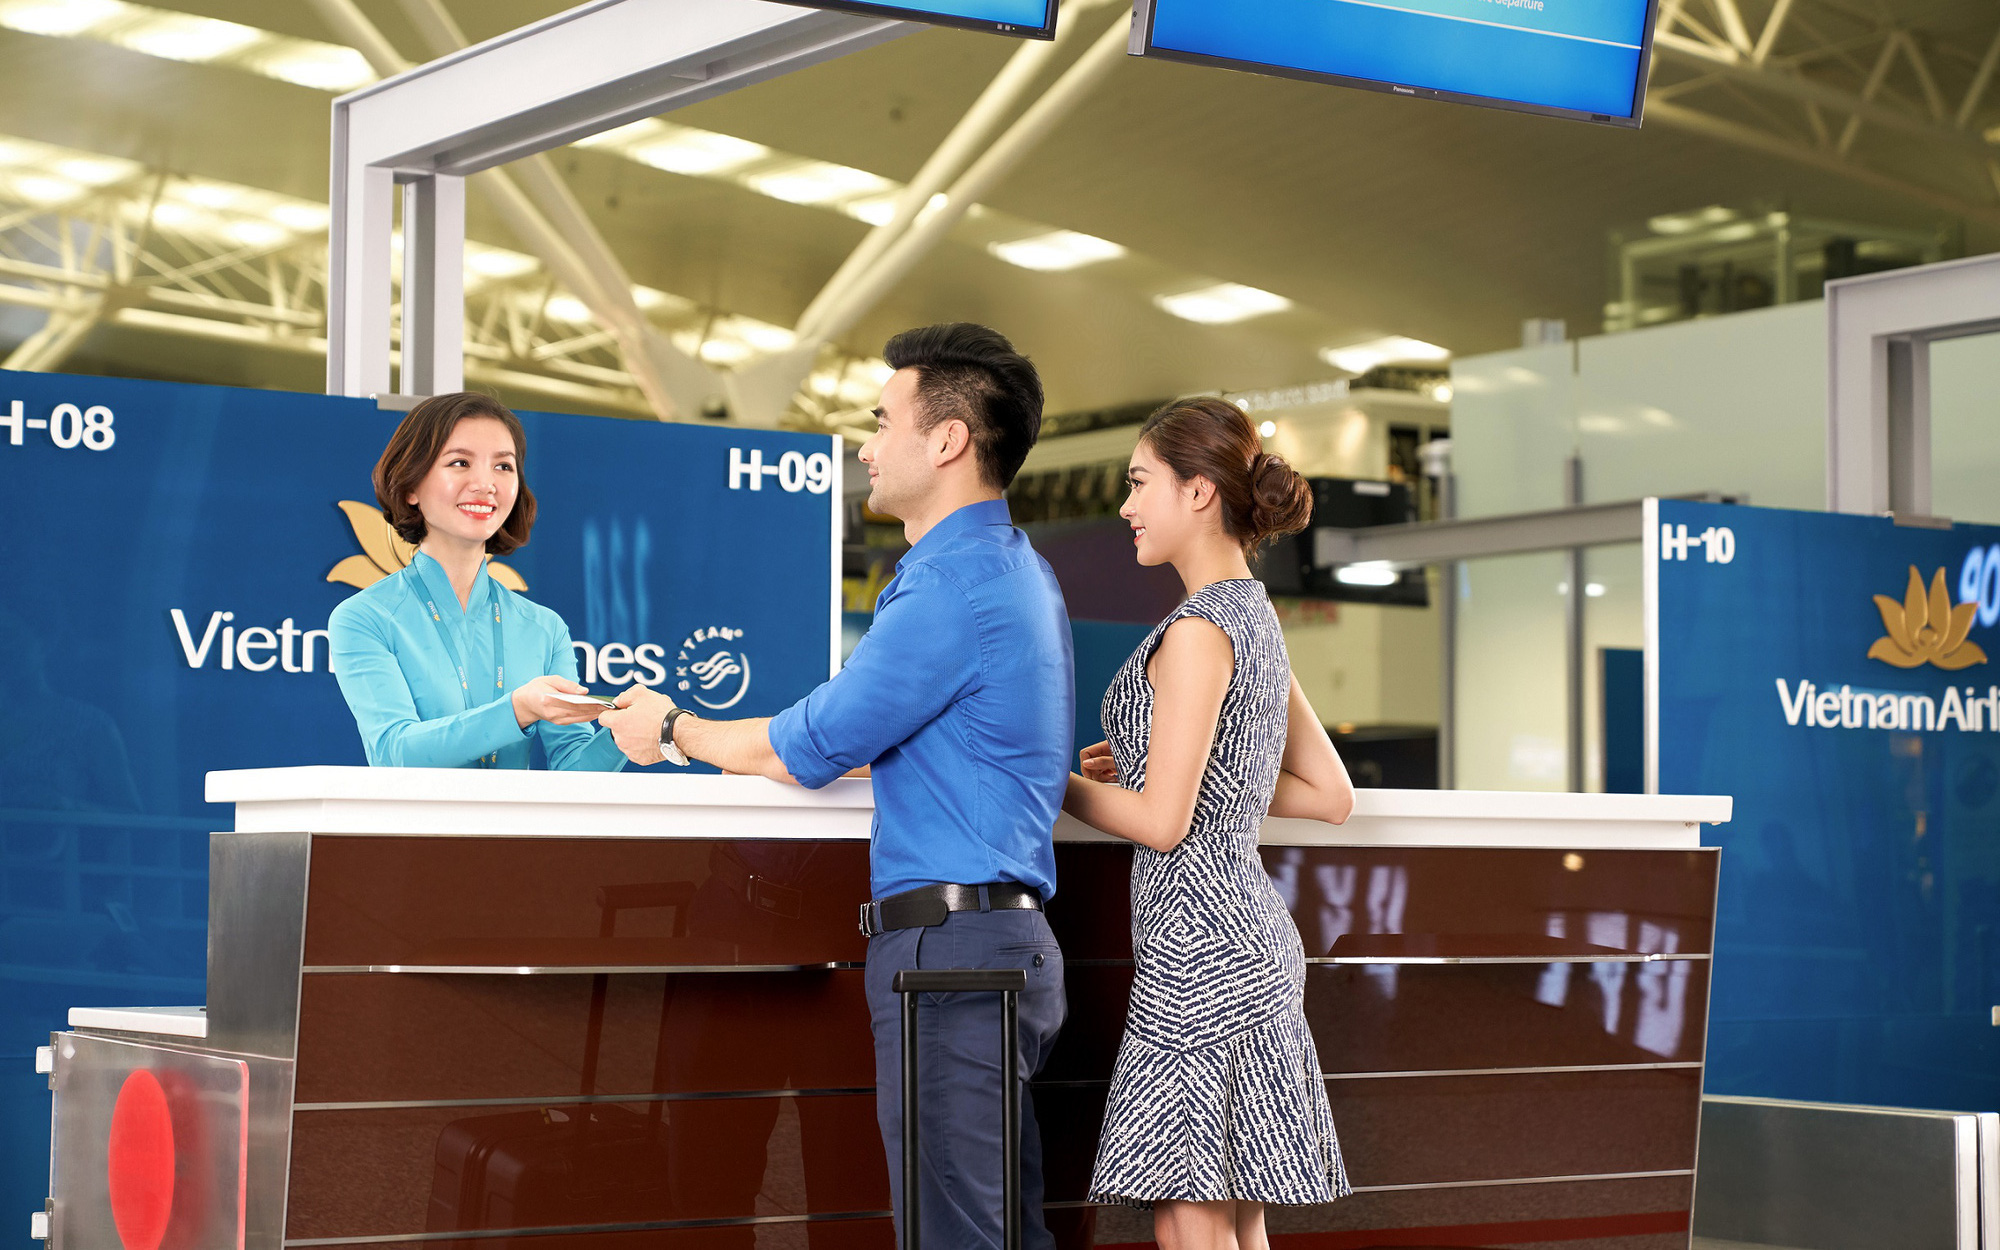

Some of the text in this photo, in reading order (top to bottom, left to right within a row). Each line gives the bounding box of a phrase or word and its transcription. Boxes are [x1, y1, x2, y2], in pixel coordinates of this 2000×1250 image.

[0, 400, 116, 451] H-08
[729, 447, 832, 494] H-09
[1661, 523, 1736, 564] H-10
[170, 608, 336, 674] Vietn
[676, 625, 735, 692] SKYTEAM
[1775, 677, 2000, 733] Vietnam Airl
